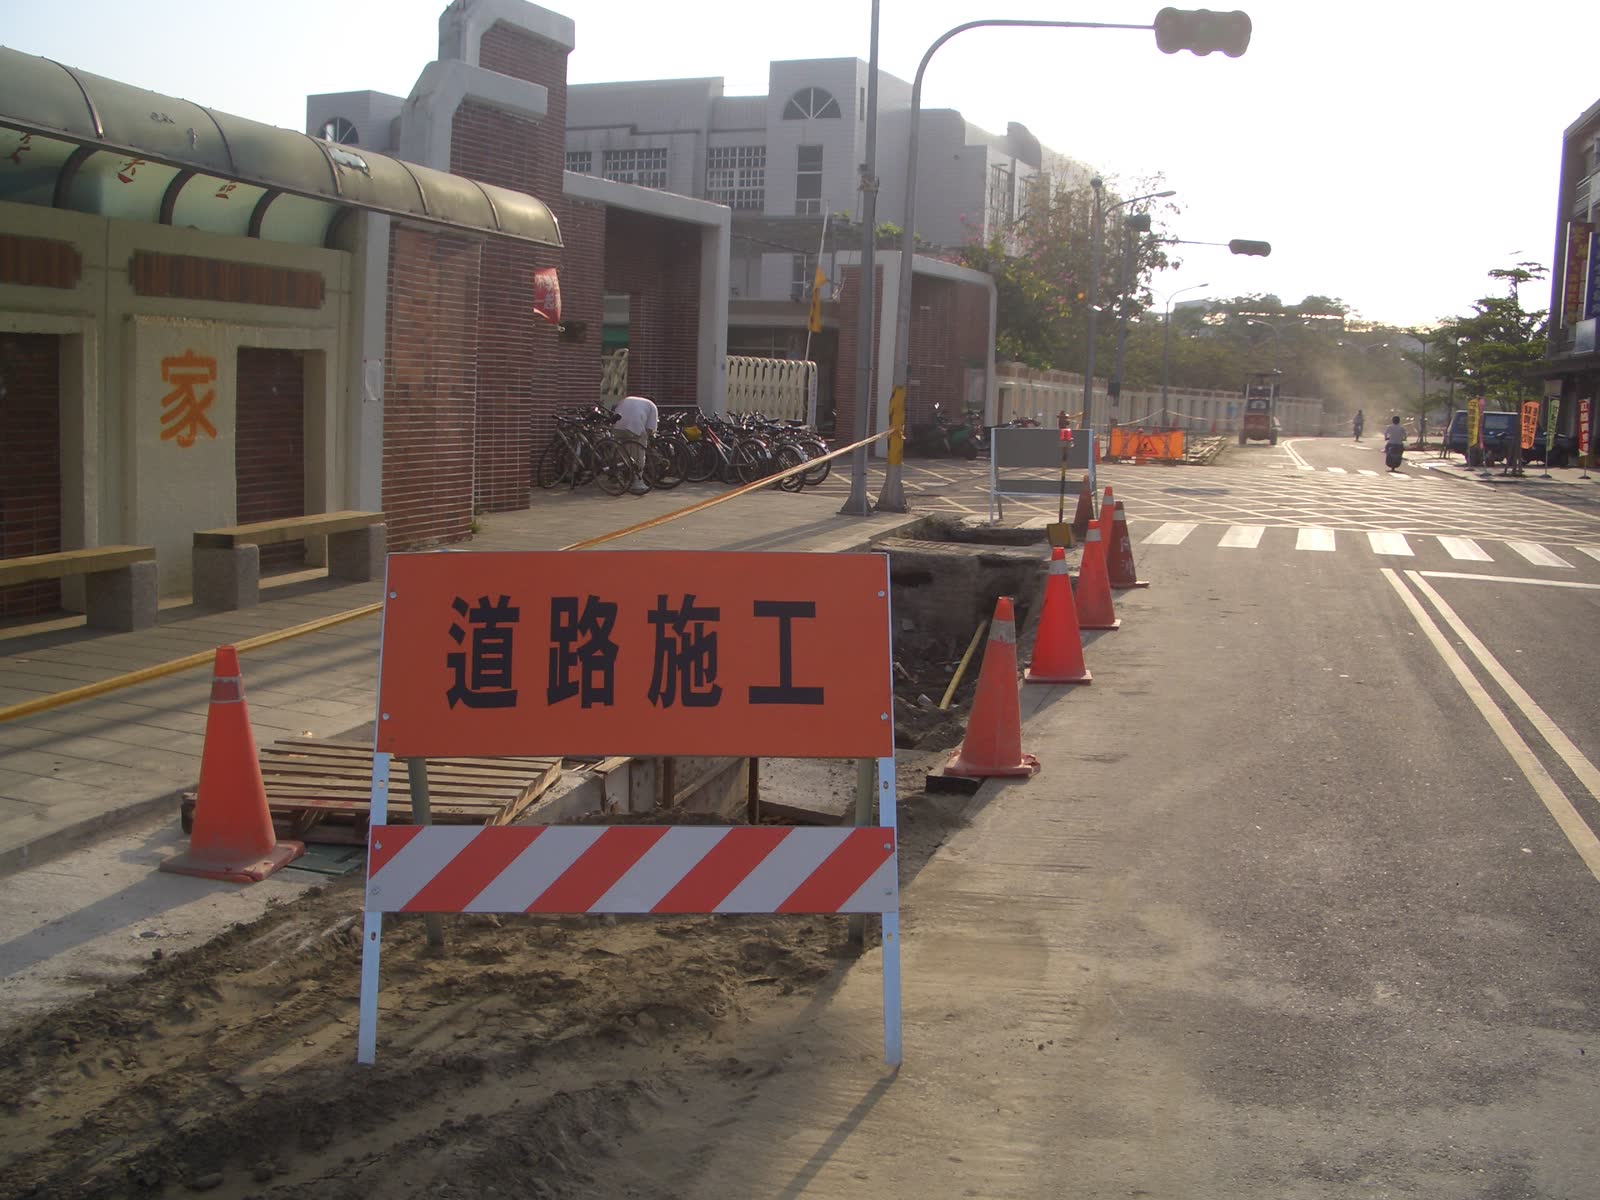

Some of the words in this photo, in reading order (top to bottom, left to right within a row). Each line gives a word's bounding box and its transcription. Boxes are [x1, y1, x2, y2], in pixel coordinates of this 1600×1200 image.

[160, 348, 218, 448] 家
[446, 593, 825, 710] 道路施工
